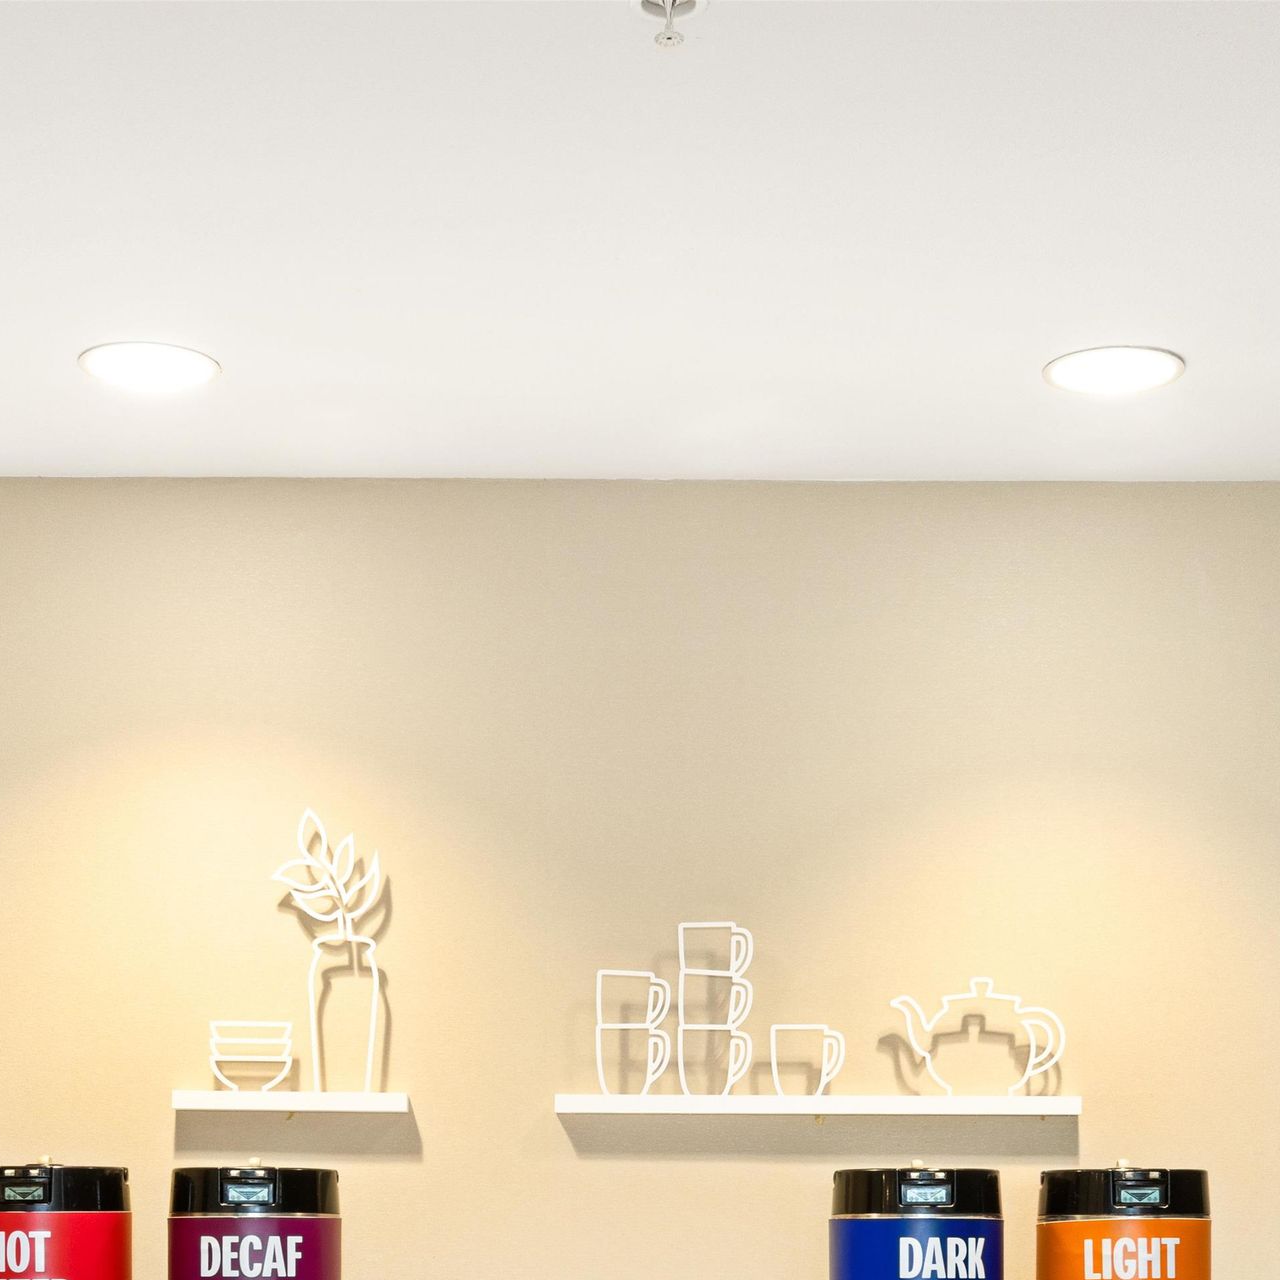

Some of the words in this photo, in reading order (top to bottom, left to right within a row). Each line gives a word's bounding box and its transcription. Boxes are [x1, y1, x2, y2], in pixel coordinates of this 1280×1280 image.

[200, 1235, 303, 1278] DECAF
[899, 1237, 986, 1280] DARK
[1083, 1237, 1180, 1280] LIGHT
